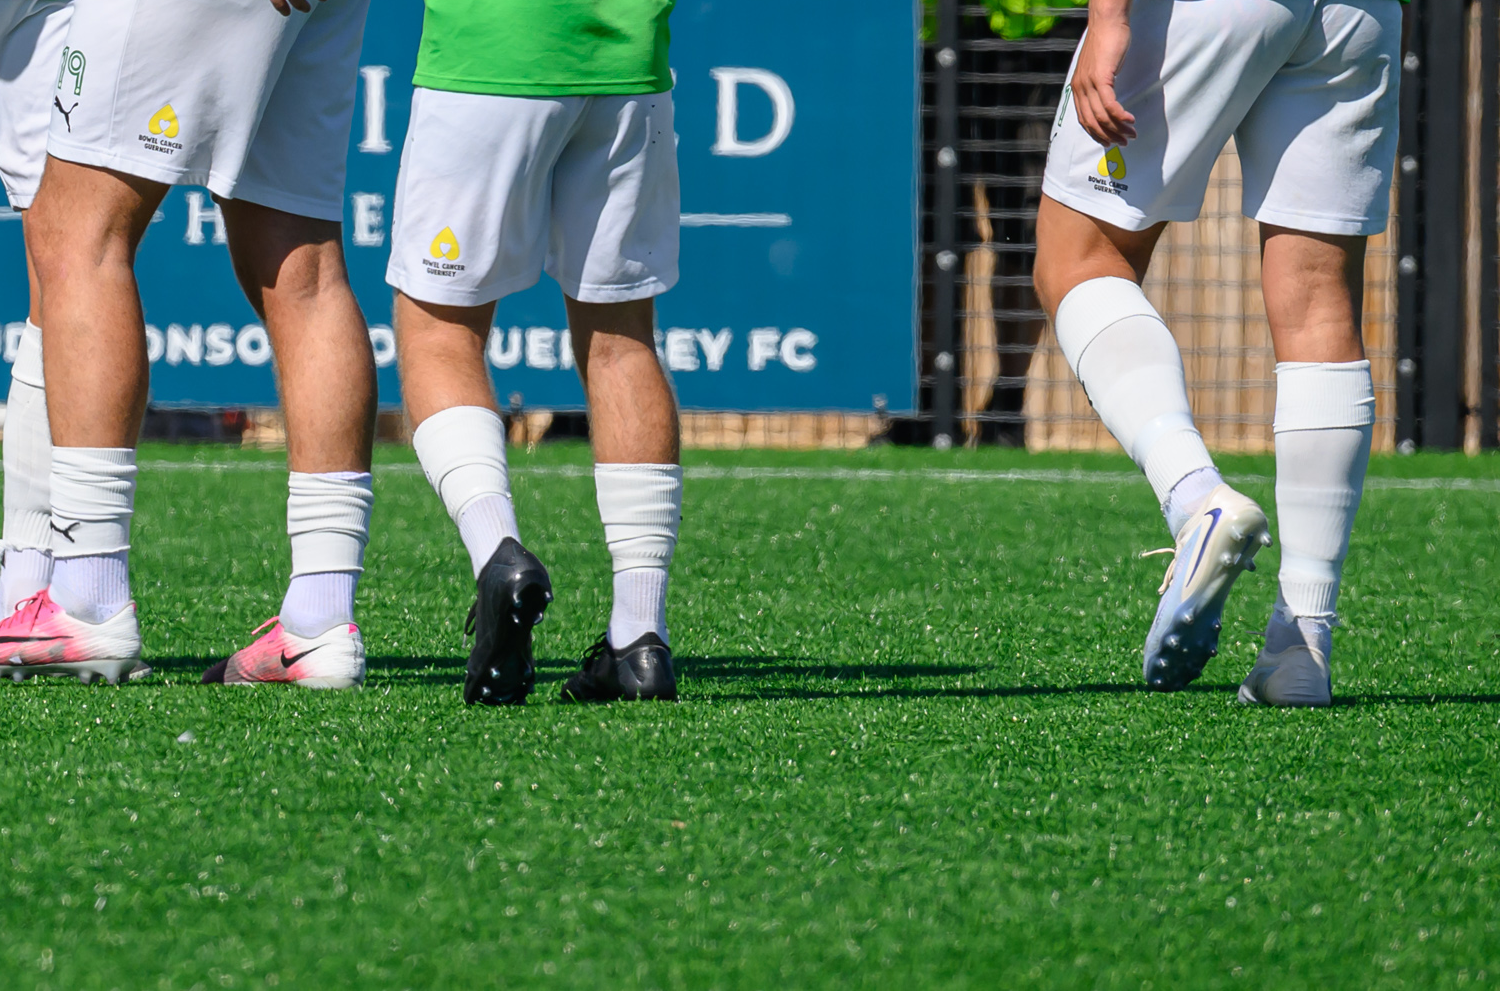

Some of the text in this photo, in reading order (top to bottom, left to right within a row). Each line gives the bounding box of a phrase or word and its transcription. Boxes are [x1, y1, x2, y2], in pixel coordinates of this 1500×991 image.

[57, 45, 86, 96] 19
[138, 134, 183, 150] BOWEL CANCER
[144, 142, 175, 155] GUERNSEY
[748, 326, 818, 373] FC
